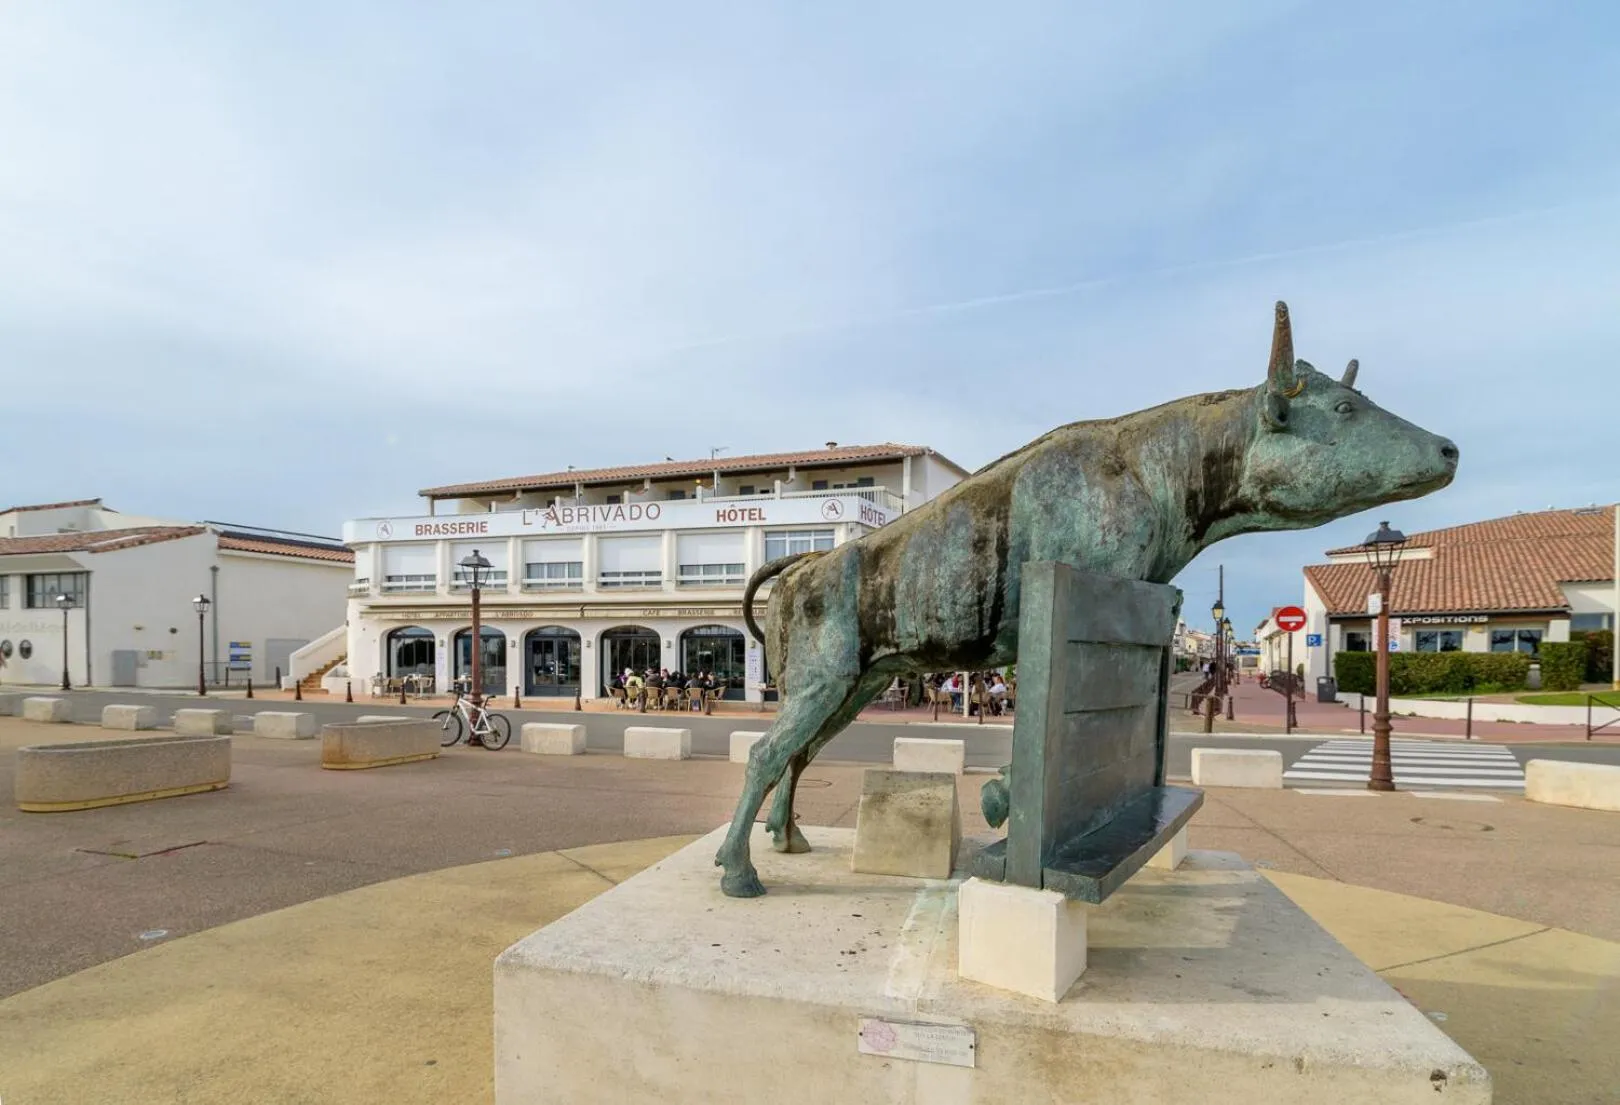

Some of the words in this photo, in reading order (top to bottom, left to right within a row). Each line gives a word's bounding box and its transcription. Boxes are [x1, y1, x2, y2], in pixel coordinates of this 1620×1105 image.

[522, 503, 661, 528] L'ABRIVADO
[716, 504, 767, 522] HÔTEL
[415, 521, 488, 536] BRASSERIE
[1402, 615, 1488, 624] XPOSITIONS
